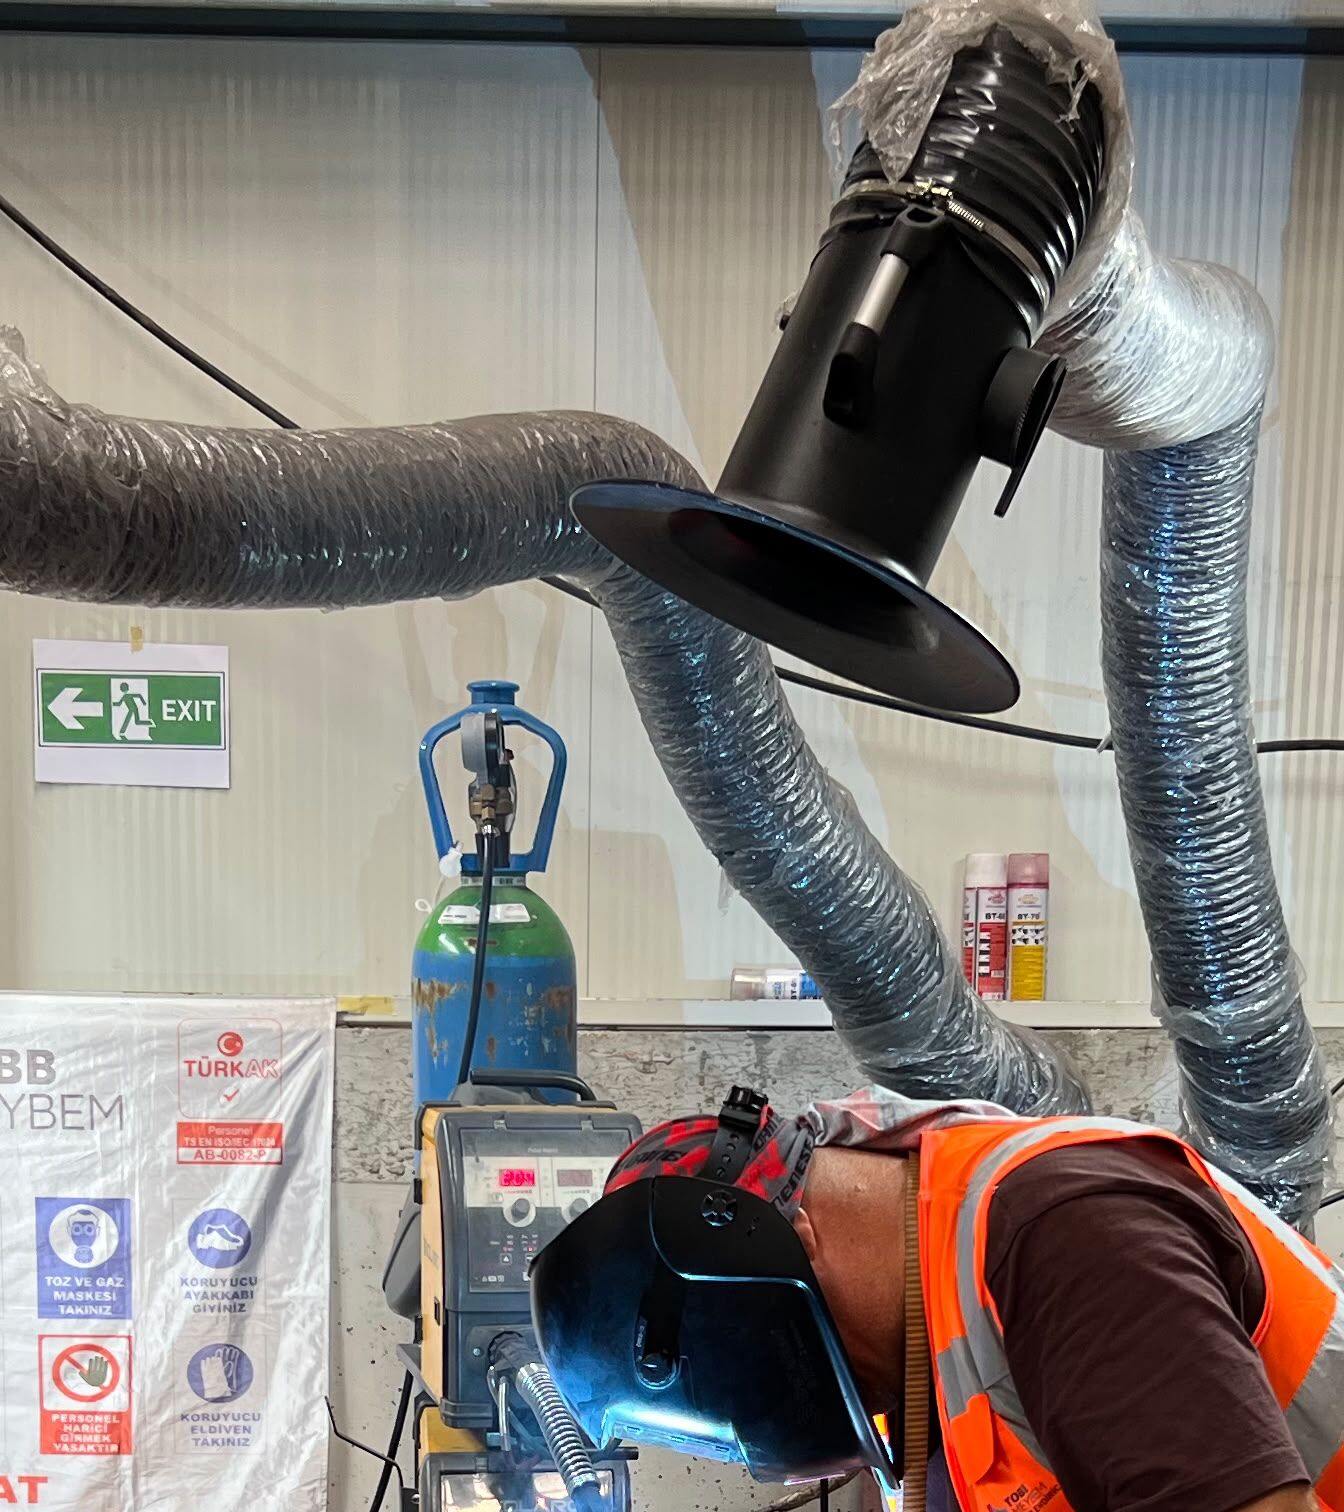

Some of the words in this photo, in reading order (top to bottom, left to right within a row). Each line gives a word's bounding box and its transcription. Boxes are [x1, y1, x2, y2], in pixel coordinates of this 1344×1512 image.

[161, 699, 217, 722] EXIT
[183, 1055, 280, 1078] TÜRKAK
[207, 1125, 253, 1136] Personel
[184, 1137, 197, 1146] TS
[199, 1137, 212, 1146] EN
[194, 1149, 266, 1161] AB-0082-P
[45, 1276, 71, 1287] TOZ
[75, 1276, 94, 1287] VE
[96, 1276, 125, 1288] GAZ
[180, 1276, 258, 1288] KORUYUCU
[53, 1290, 116, 1302] MASKESİ
[184, 1290, 254, 1301] AYAKKABI
[58, 1304, 112, 1316] TAKINIZ
[192, 1303, 247, 1313] GİYİNİZ
[51, 1413, 120, 1424] PERSONEL
[180, 1412, 261, 1422] KORUYUCU
[190, 1424, 252, 1435] ELDİVEN
[192, 1437, 251, 1447] TAKINIZ
[53, 1443, 120, 1453] YASAKTIR
